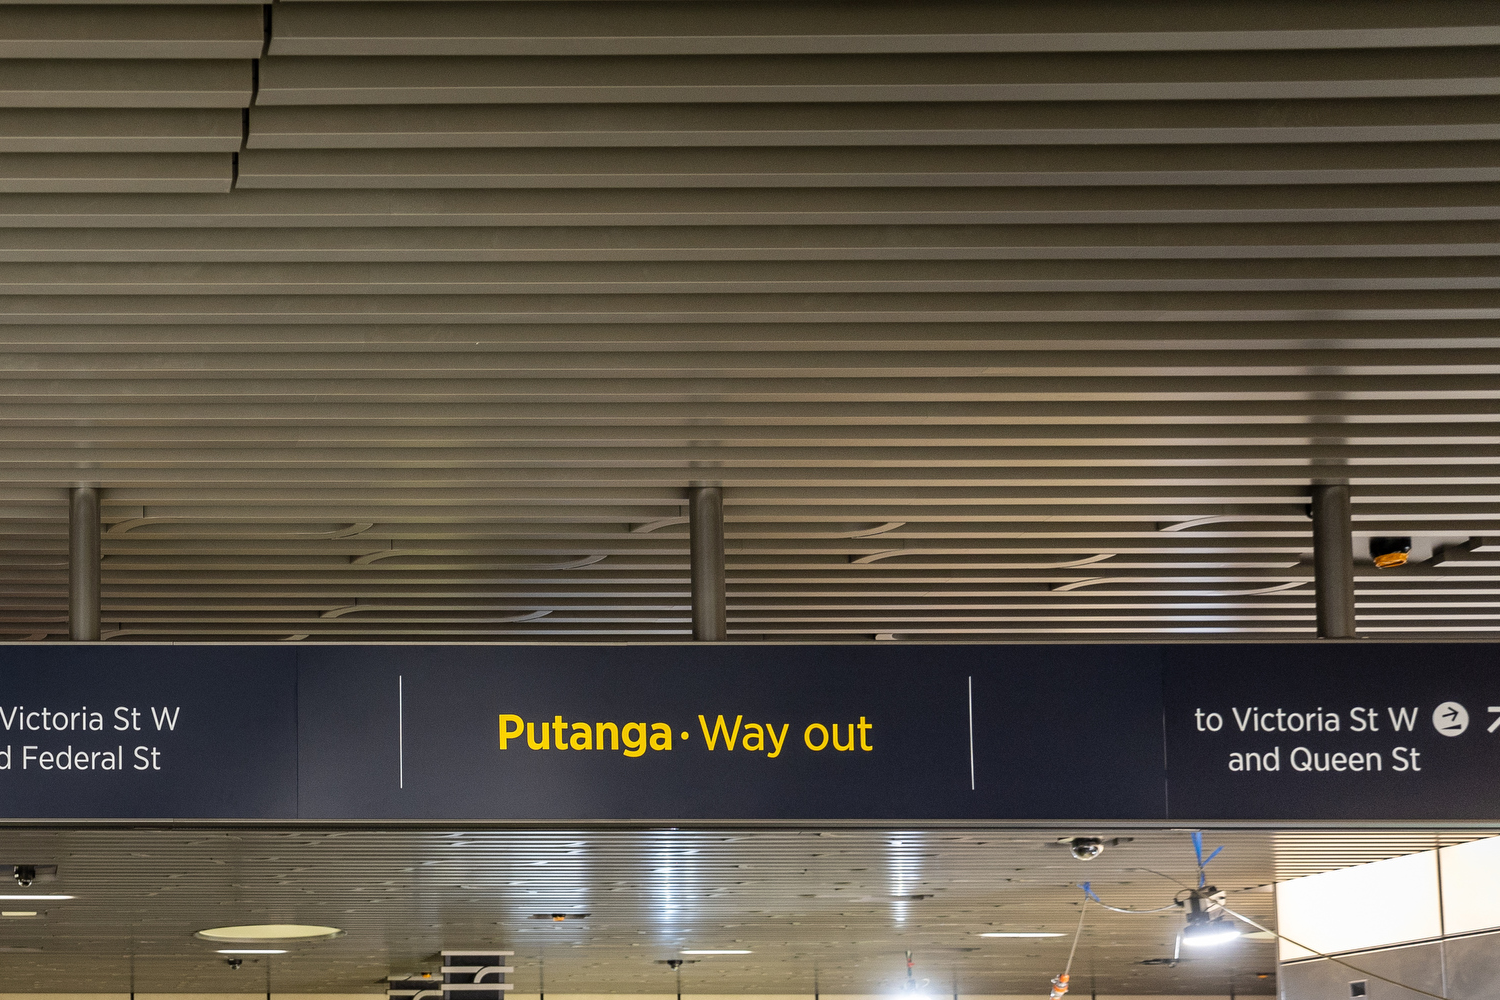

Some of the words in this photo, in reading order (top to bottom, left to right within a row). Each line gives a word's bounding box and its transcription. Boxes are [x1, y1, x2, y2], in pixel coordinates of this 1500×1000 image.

[113, 706, 141, 731] St
[150, 706, 180, 731] W
[1195, 707, 1223, 732] to
[1231, 706, 1340, 732] Victoria
[1350, 706, 1379, 732] St
[1388, 707, 1419, 732] W
[698, 714, 790, 758] Way
[804, 716, 873, 752] out
[23, 745, 123, 771] Federal
[133, 745, 161, 771] St
[1228, 746, 1280, 772] and
[1290, 747, 1382, 772] Queen
[1391, 747, 1422, 772] St
